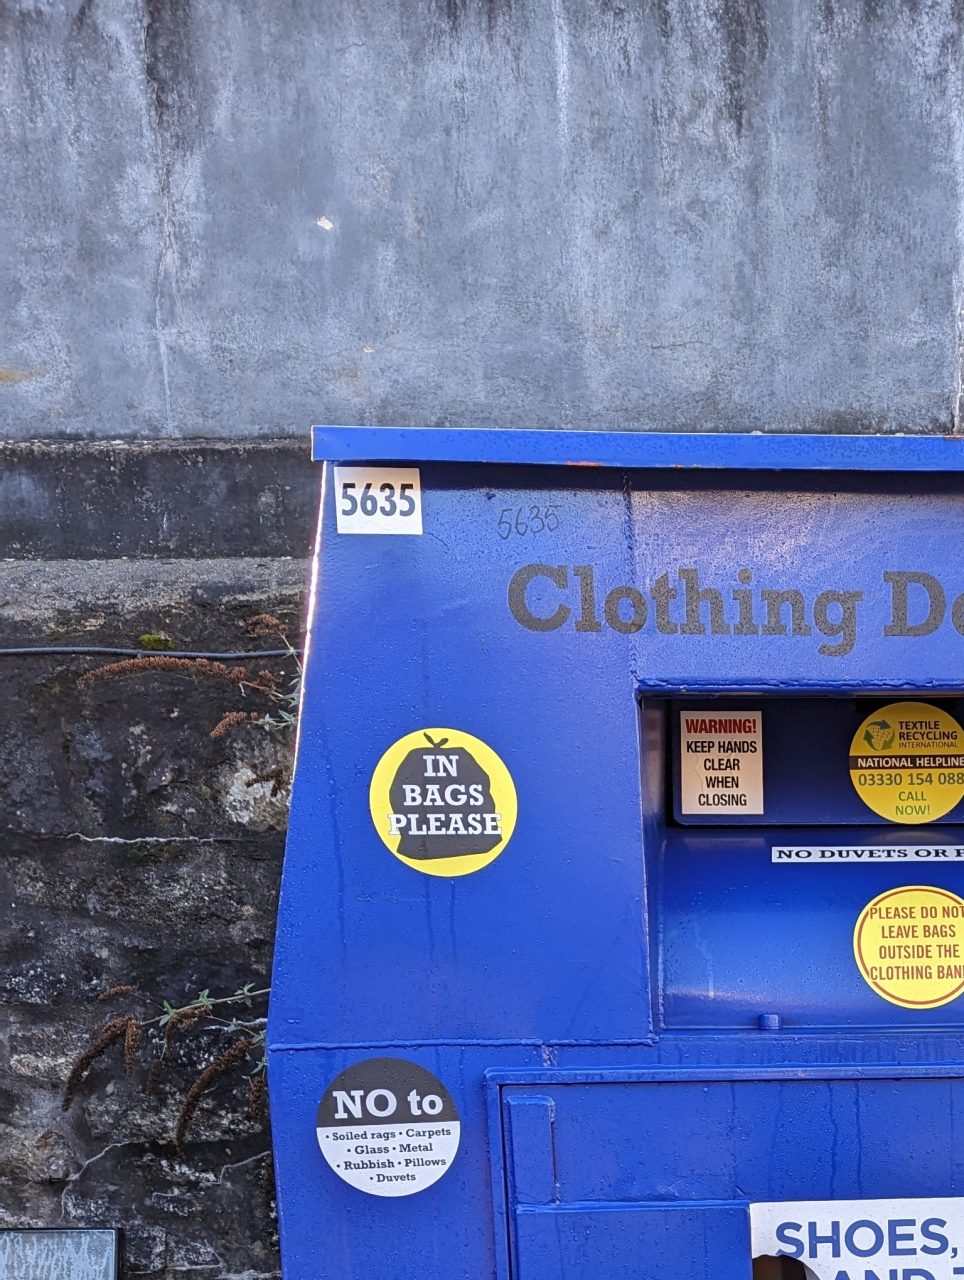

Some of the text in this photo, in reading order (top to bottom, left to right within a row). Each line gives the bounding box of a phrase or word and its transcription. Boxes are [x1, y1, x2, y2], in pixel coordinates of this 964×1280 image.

[341, 483, 416, 516] 5635
[497, 505, 562, 540] 5635
[508, 563, 864, 656] Clothing
[685, 719, 756, 733] WARNING!
[898, 721, 940, 729] TEXTILE
[899, 731, 958, 740] RECYCLING
[687, 741, 757, 753] KEEP HANDS
[423, 755, 459, 776] IN
[704, 759, 740, 770] CLEAR
[858, 757, 964, 767] NATIONAL HELPLINE
[706, 776, 739, 788] WHEN
[859, 773, 964, 785] 03330 154 088
[403, 784, 484, 806] BAGS
[698, 794, 747, 806] CLOSING
[899, 791, 926, 801] CALL
[896, 805, 930, 815] NOW!
[388, 813, 502, 835] PLEASE
[776, 850, 812, 859] NO
[819, 849, 908, 859] DUVETS
[914, 849, 949, 858] OR
[870, 907, 916, 919] PLEASE
[921, 906, 937, 918] DO
[882, 924, 956, 938] LEAVE BAGS
[879, 944, 960, 959] OUTSIDE THE
[870, 966, 932, 980] CLOTHING
[332, 1089, 443, 1119] NO to
[333, 1128, 451, 1143] Soiled rags Carpets
[355, 1143, 433, 1154] Glass Metal
[344, 1158, 446, 1170] Rubbish Pillows
[376, 1173, 416, 1182] Duvets
[775, 1219, 958, 1259] SHOES,
